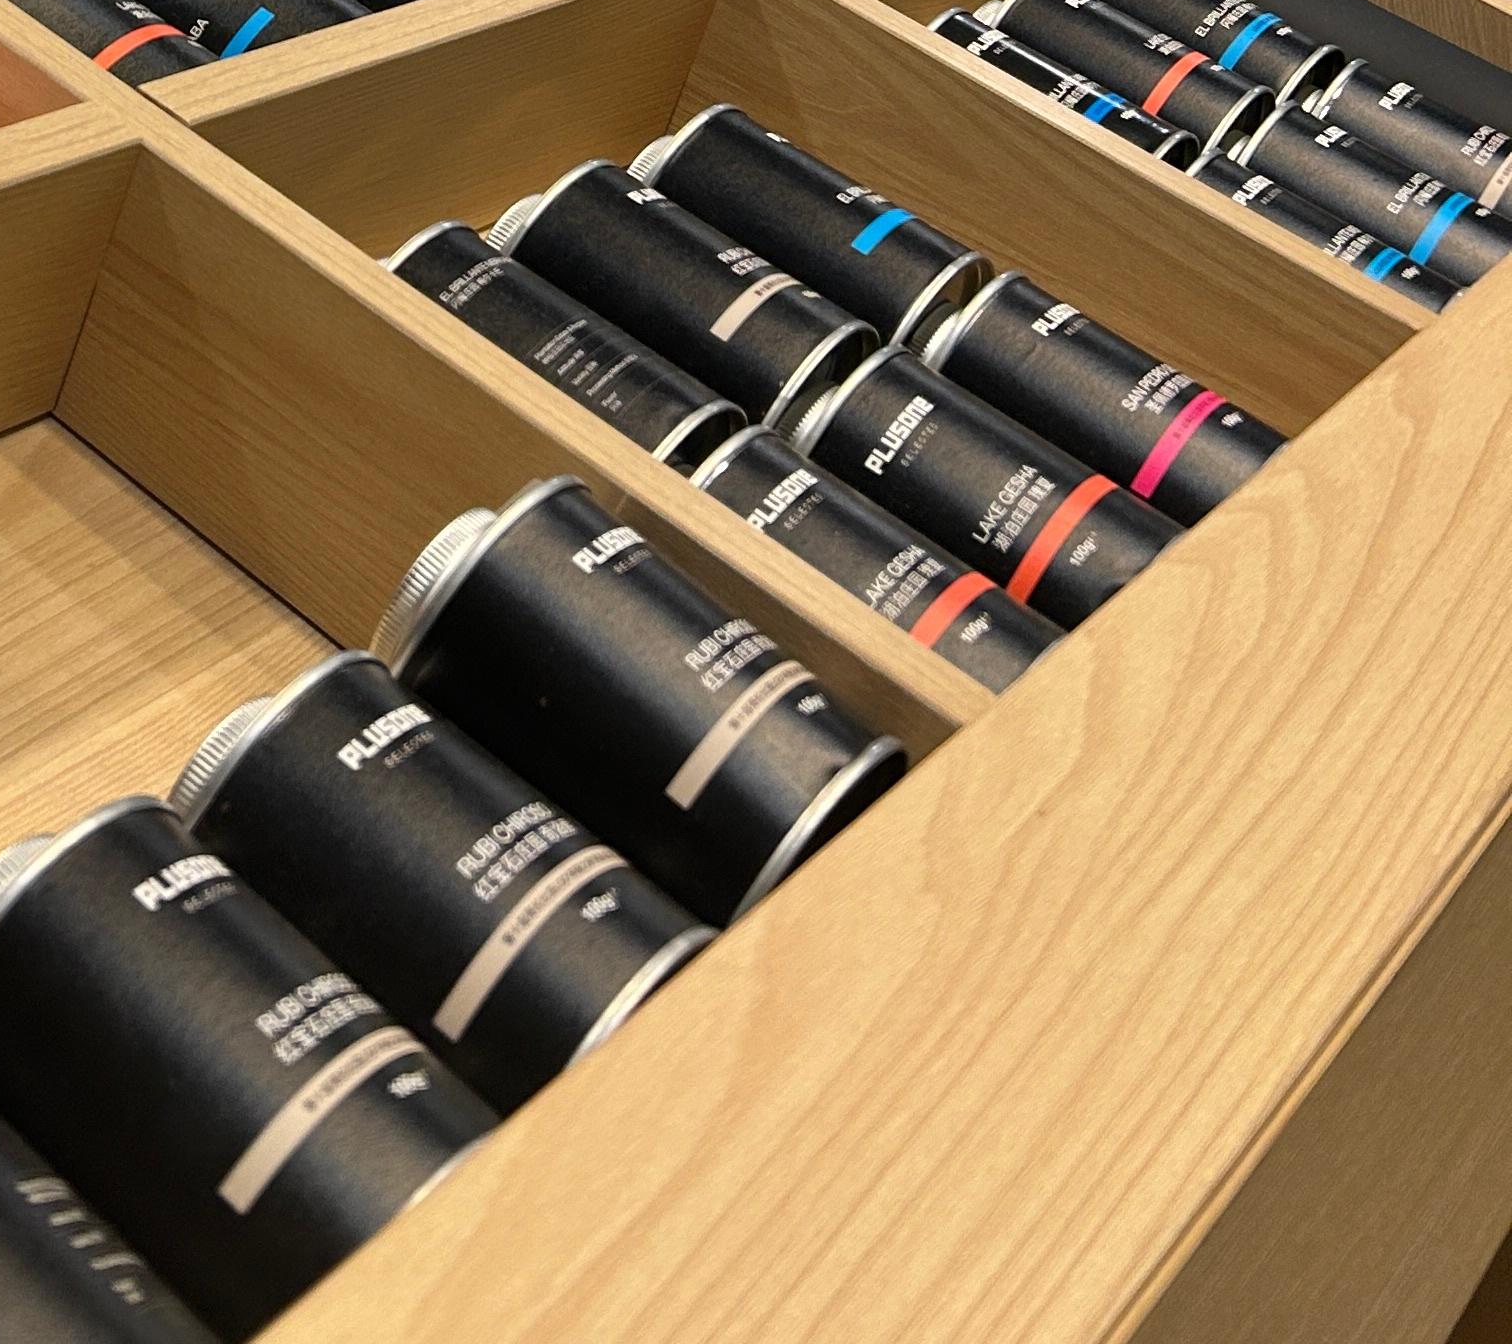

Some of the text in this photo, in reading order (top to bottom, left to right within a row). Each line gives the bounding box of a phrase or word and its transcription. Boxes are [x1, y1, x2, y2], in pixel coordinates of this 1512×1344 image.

[972, 464, 1038, 545] LAKE GESHA
[886, 544, 926, 579] GESHA
[685, 635, 722, 673] RUBI
[456, 833, 502, 880] RUBI
